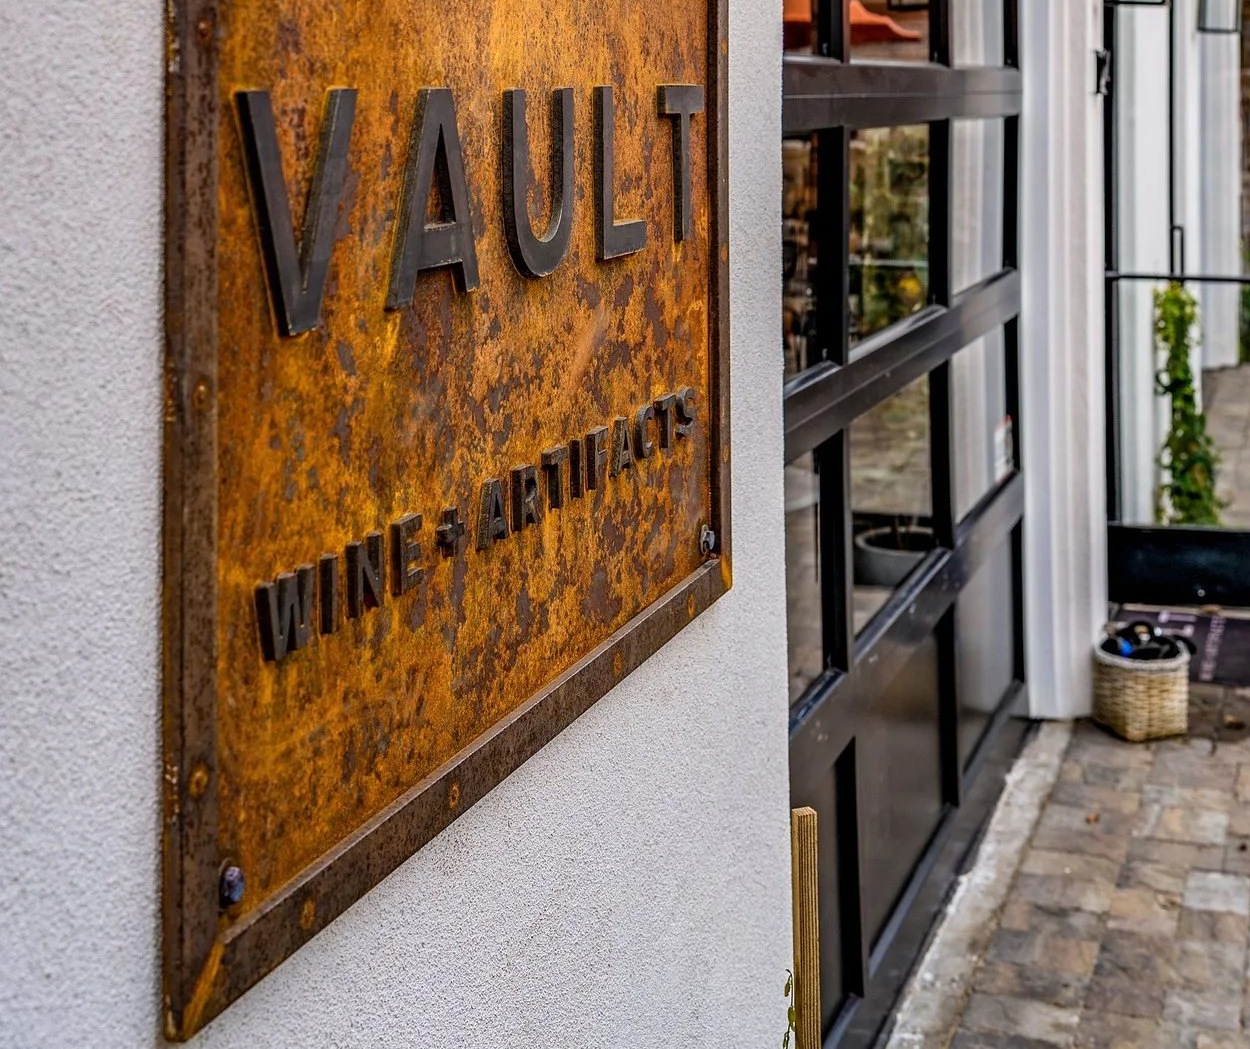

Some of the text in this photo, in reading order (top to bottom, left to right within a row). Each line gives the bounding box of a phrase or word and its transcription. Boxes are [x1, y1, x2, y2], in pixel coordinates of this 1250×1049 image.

[235, 85, 700, 337] VAULT
[254, 513, 423, 661] WINE
[476, 386, 698, 551] ARTIFACTS
